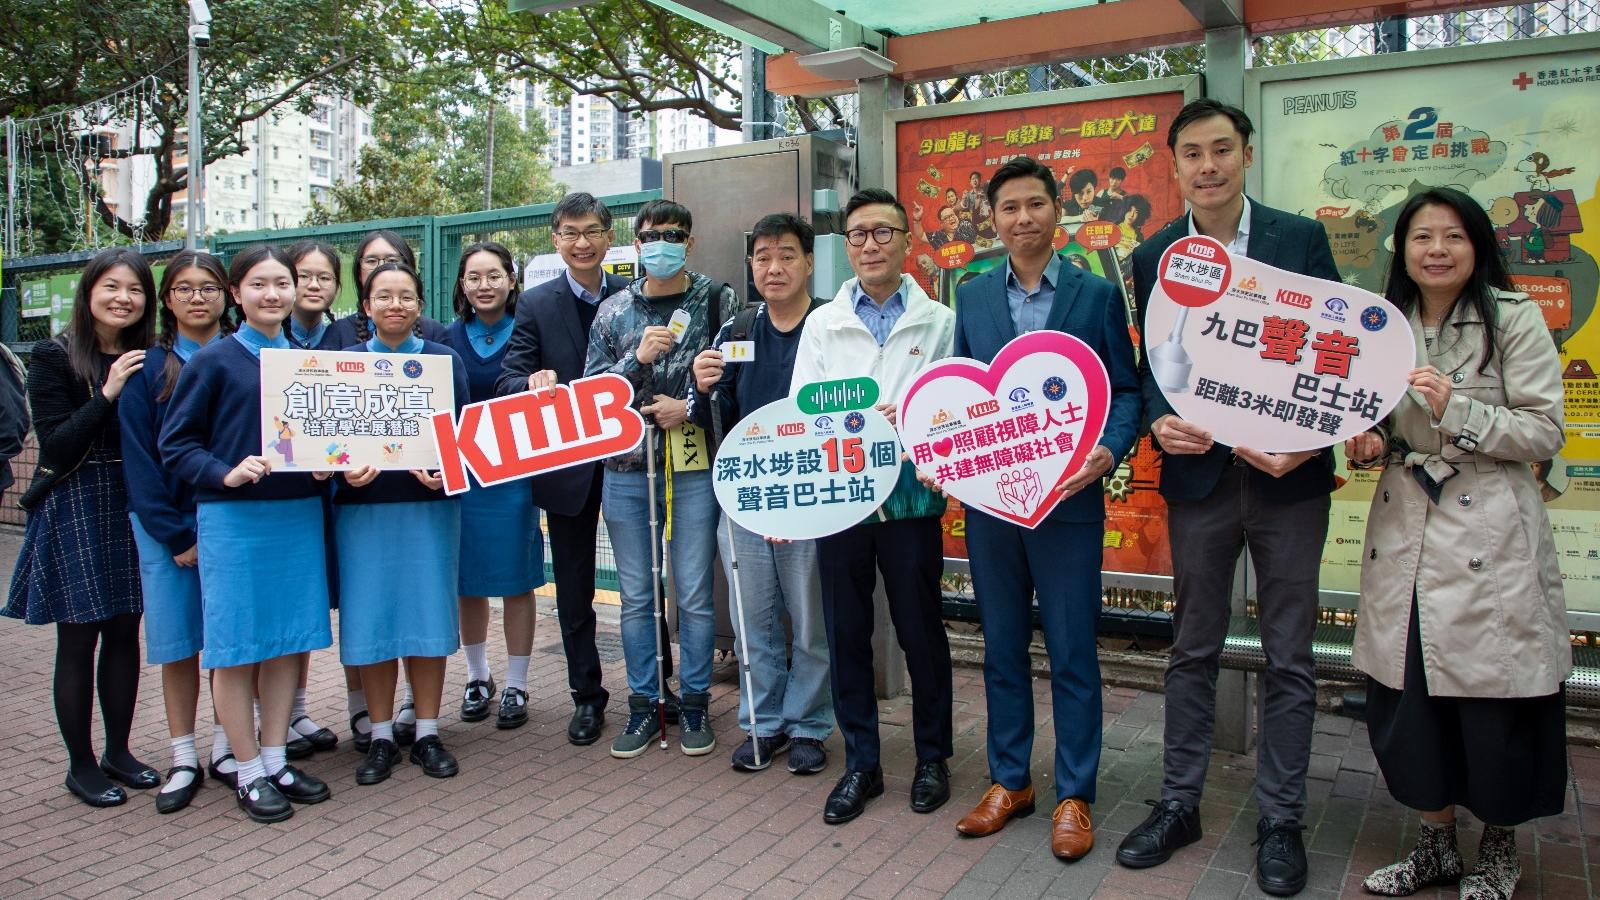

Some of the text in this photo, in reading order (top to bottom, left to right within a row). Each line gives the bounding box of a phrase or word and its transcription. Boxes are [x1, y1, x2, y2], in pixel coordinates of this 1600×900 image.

[1537, 79, 1559, 87] HONG
[1561, 77, 1583, 85] KONG
[1283, 91, 1358, 115] PEANUTS
[1340, 138, 1490, 166] 紅十字會定向挑戰
[1187, 243, 1215, 258] KMB
[1170, 256, 1223, 279] 深水埗區
[1174, 272, 1190, 281] Sham
[1191, 276, 1204, 284] Shui
[1275, 288, 1313, 309] KMB
[1201, 311, 1361, 379] 九巴聲音
[336, 361, 365, 373] KMB
[283, 382, 435, 420] 創意成真
[967, 399, 1000, 420] KMB
[1194, 377, 1344, 437] 距離3米即發聲
[1291, 373, 1383, 422] 巴士站
[304, 419, 419, 437] 培育學生展潛能
[431, 375, 645, 494] KMB
[776, 422, 806, 437] KMB
[717, 437, 897, 481] 深水埗設15個
[936, 431, 1075, 485] 共建無障礙社會
[738, 476, 875, 512] 聲音巴士站
